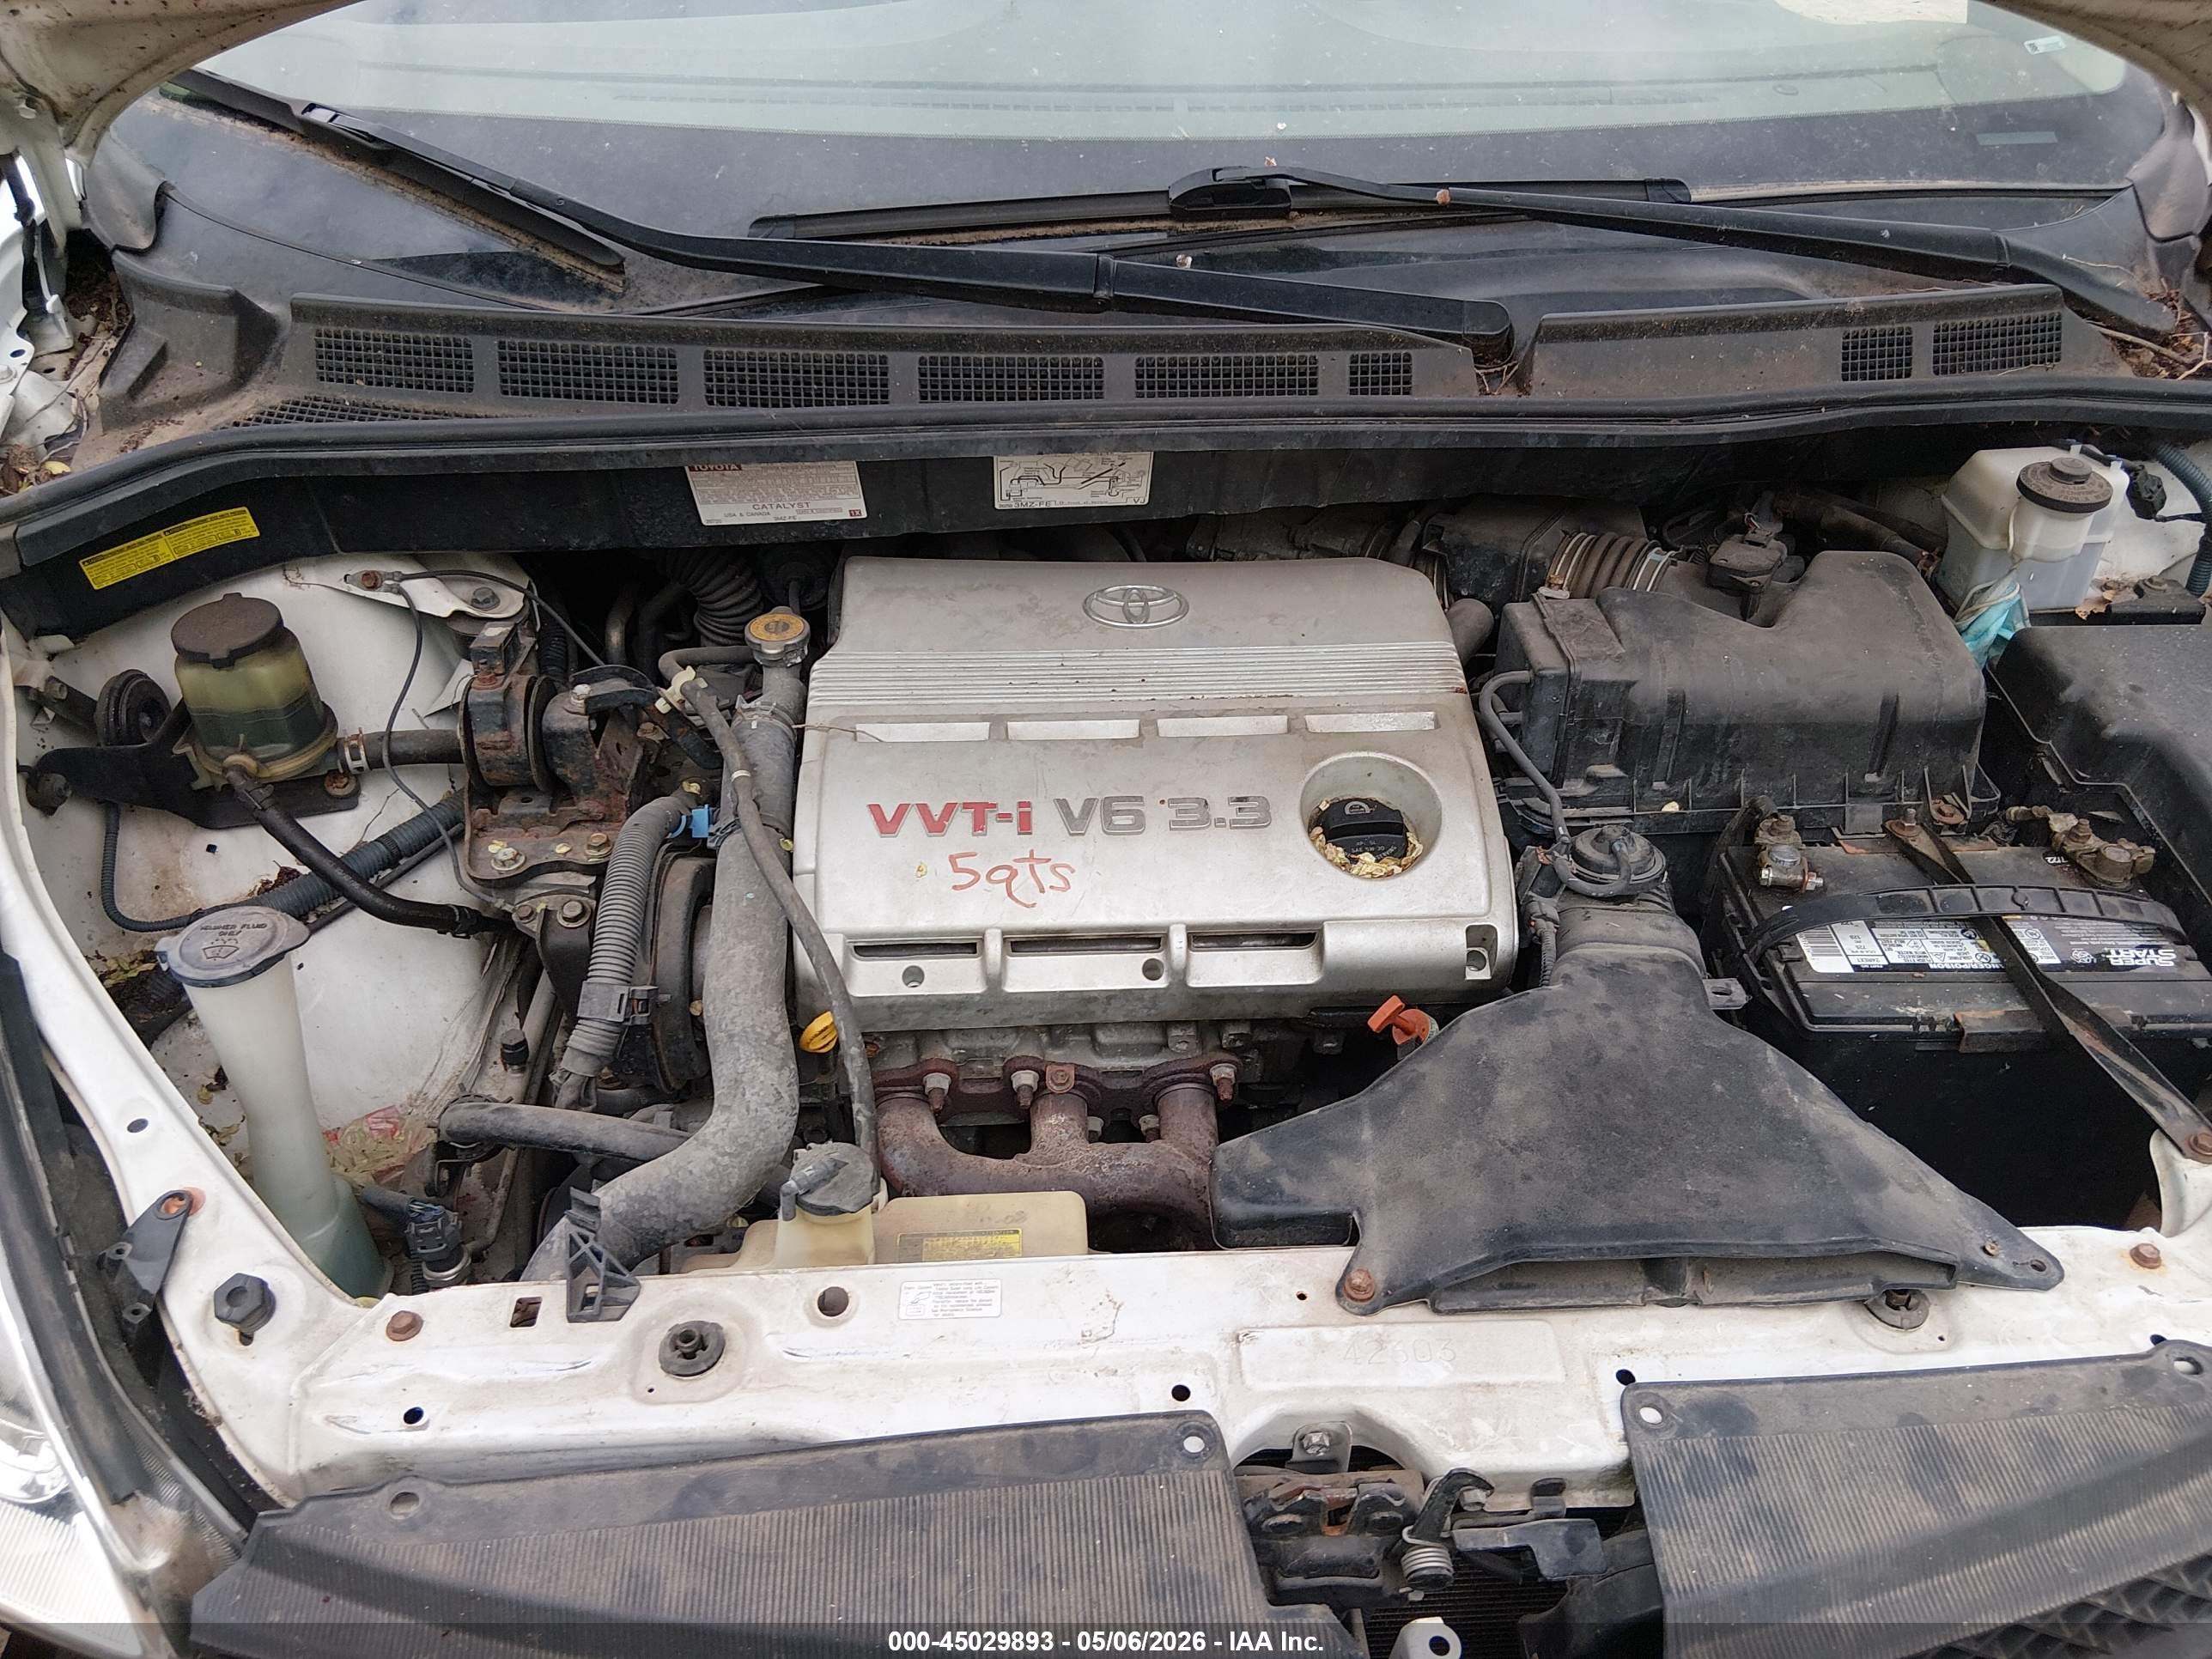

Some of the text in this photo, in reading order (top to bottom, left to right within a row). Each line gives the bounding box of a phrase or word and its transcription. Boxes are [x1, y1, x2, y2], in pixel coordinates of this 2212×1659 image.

[752, 501, 811, 511] CATALYST
[867, 795, 1273, 836] VVT-i V6 3.3
[948, 849, 1076, 908] 5qts
[2106, 949, 2176, 958] START
[2109, 957, 2175, 967] SUPER
